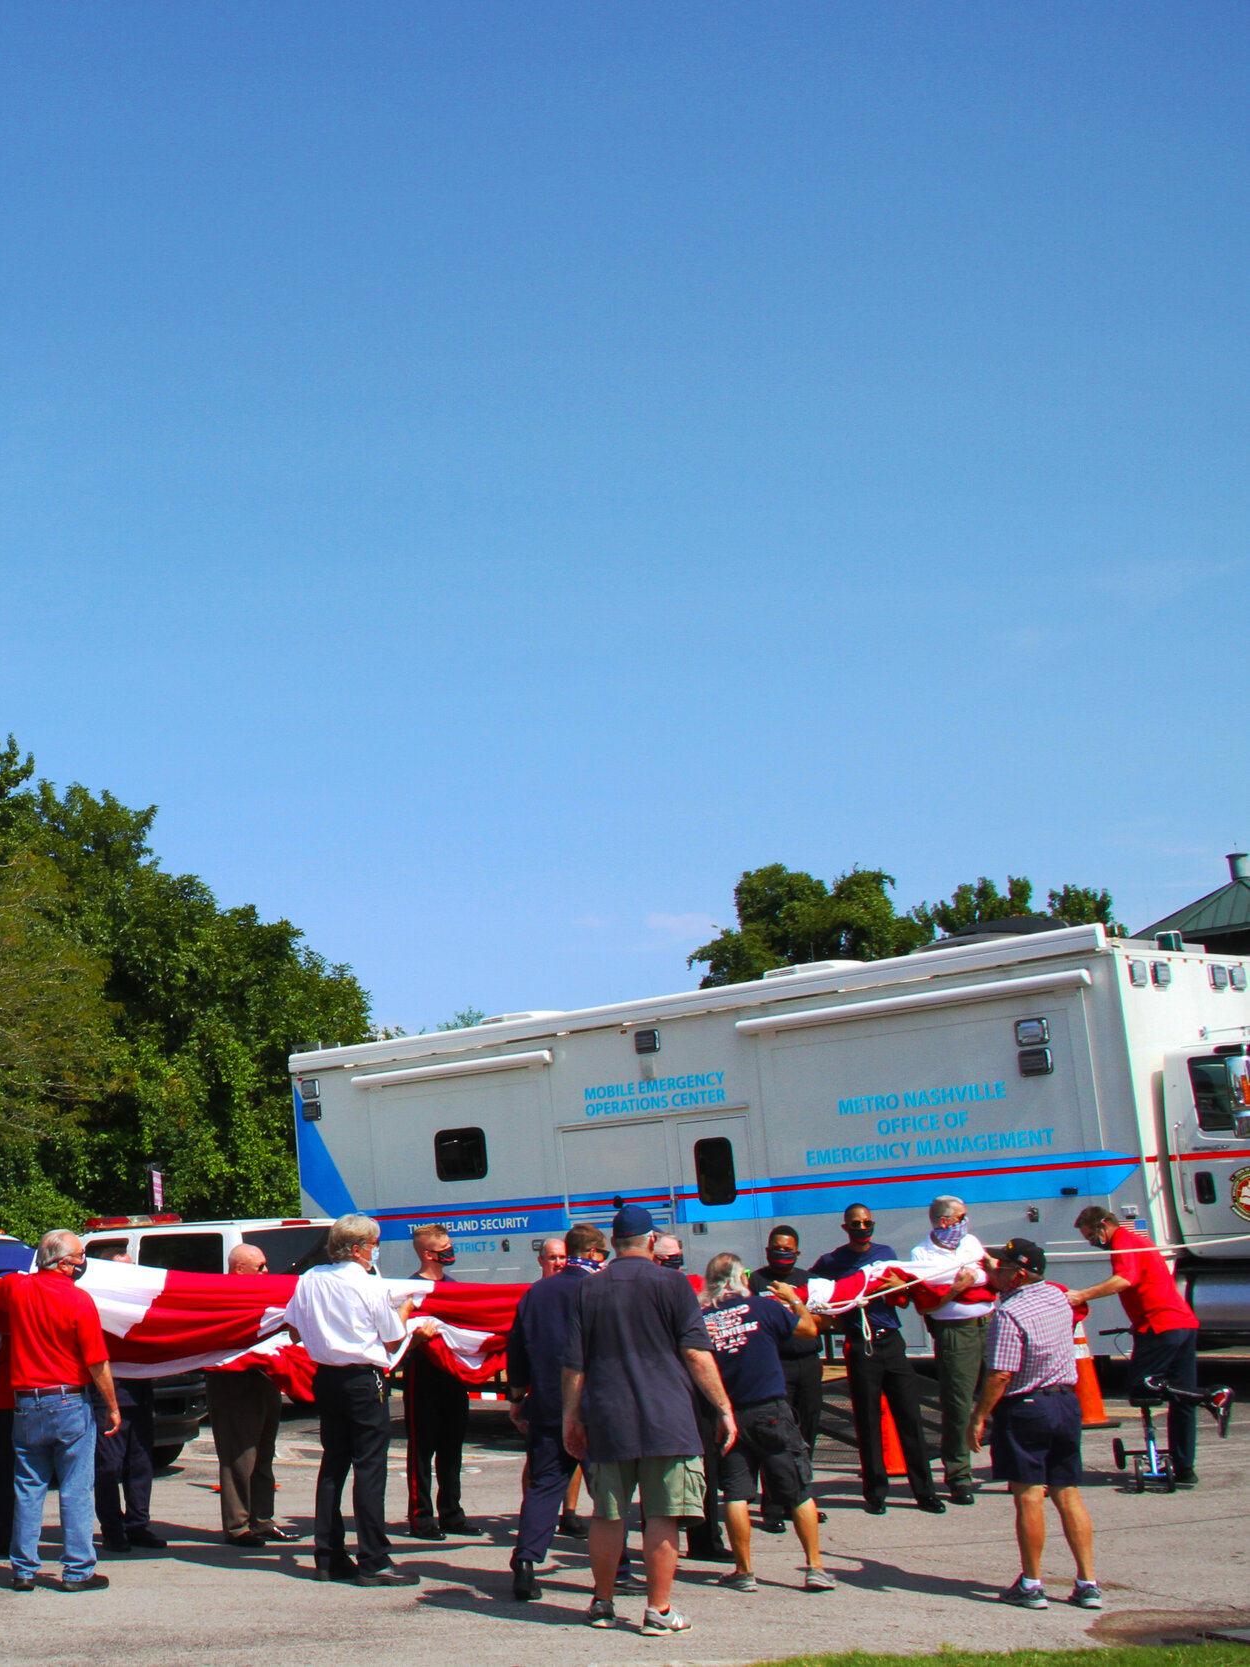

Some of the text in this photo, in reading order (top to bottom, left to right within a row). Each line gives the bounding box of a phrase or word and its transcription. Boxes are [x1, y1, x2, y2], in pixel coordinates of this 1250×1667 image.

[584, 1071, 725, 1101] MOBILE EMERGENCY
[838, 1081, 1007, 1115] METRO NASHVILLE
[585, 1088, 726, 1117] OPERATIONS CENTER
[877, 1111, 969, 1136] OFFICE OF
[806, 1128, 1055, 1167] EMERGENCY MANAGEMENT
[480, 1217, 529, 1230] SECURITY
[489, 1240, 497, 1252] 5
